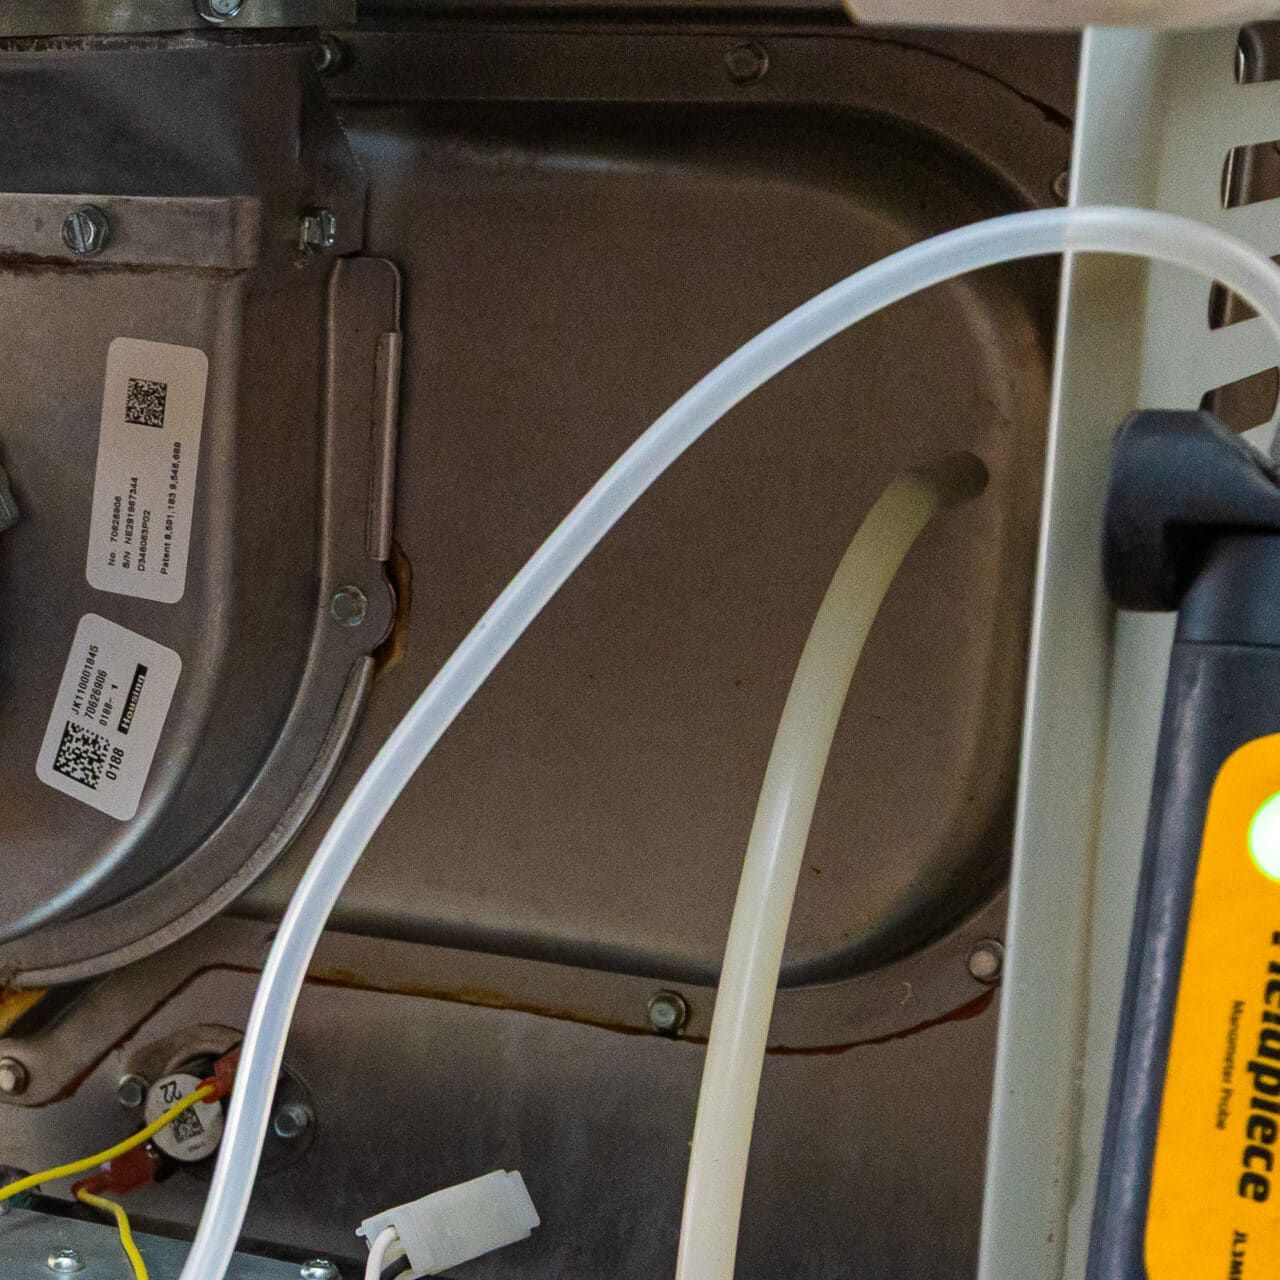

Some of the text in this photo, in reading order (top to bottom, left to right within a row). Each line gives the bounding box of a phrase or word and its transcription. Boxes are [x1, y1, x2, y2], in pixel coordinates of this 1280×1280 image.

[160, 542, 171, 574] Patent
[120, 674, 145, 728] Housing
[105, 747, 124, 779] 0188
